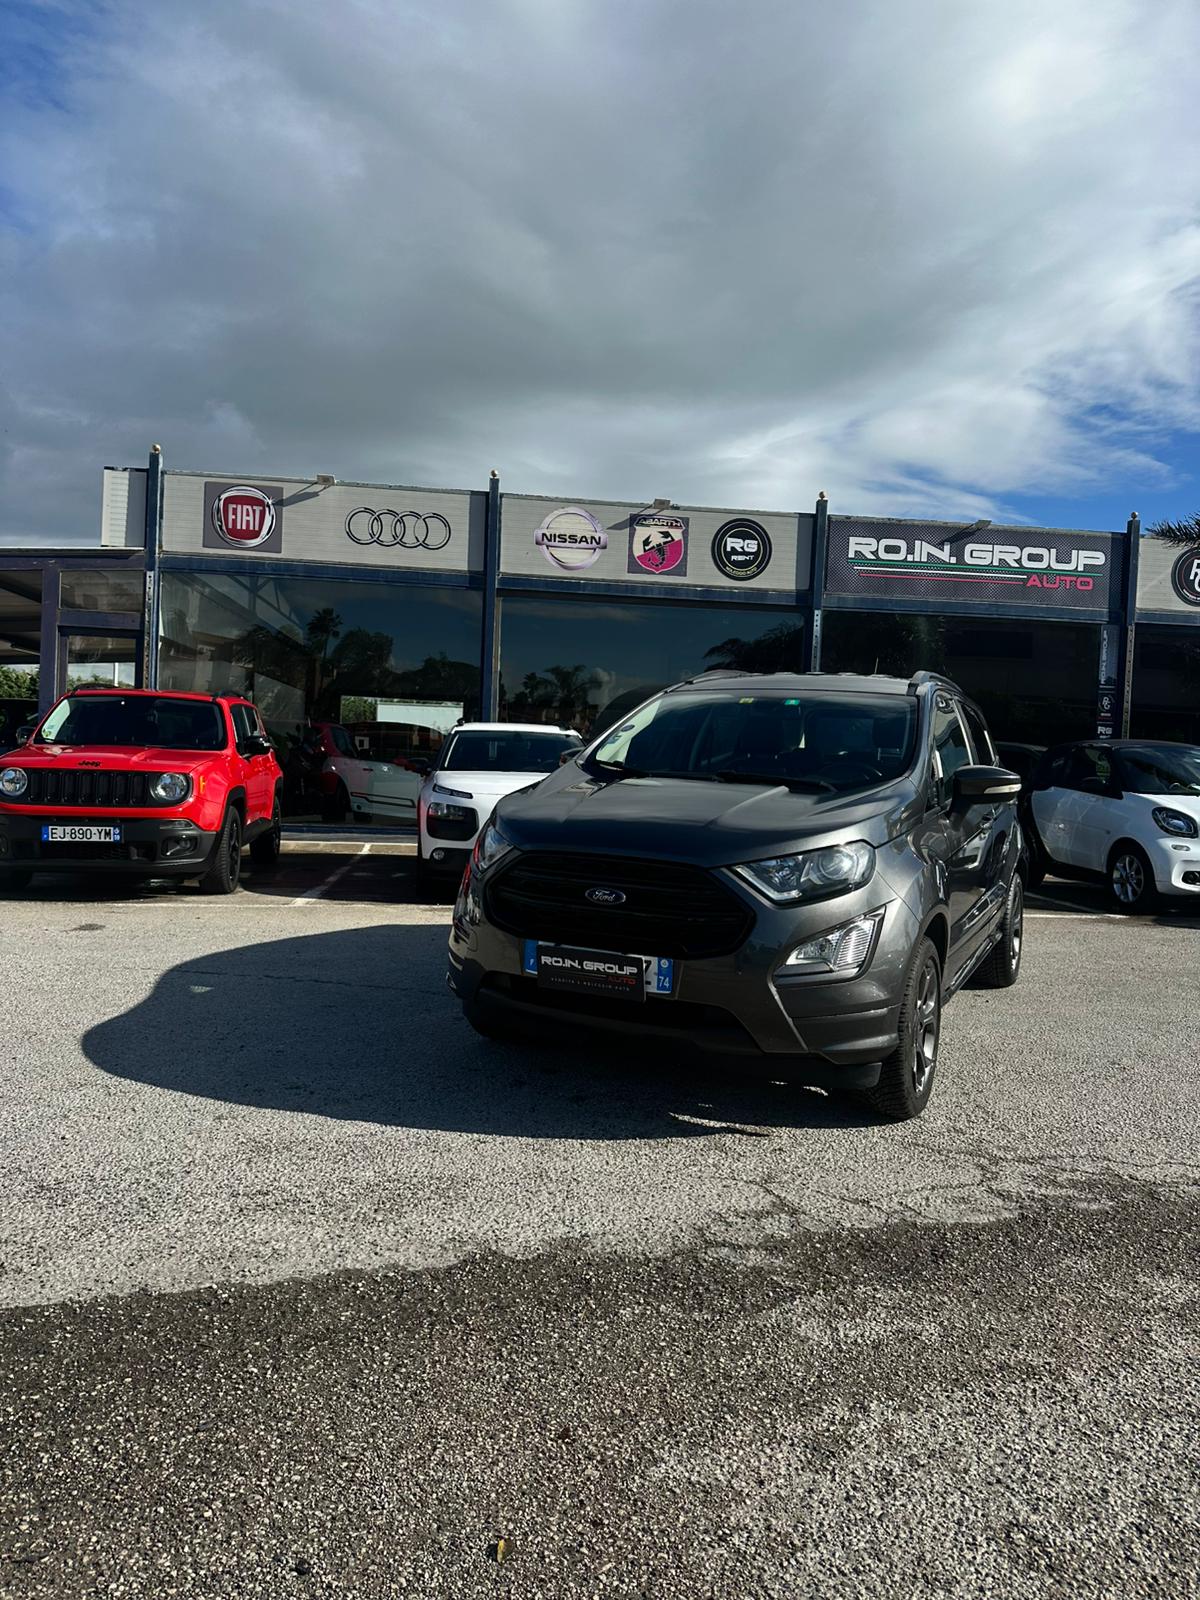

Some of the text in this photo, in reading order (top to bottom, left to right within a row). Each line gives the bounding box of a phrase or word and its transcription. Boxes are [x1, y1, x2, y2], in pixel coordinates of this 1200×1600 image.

[227, 503, 263, 531] FIAT
[639, 518, 681, 527] ABARTH
[541, 532, 601, 545] NISSAN
[726, 537, 758, 552] RG
[848, 536, 1106, 571] RO.IN. GROUP
[1026, 575, 1094, 590] AUTO
[592, 889, 616, 902] Ford
[541, 955, 581, 969] RO.IN.
[583, 961, 638, 975] GROUP
[608, 976, 636, 985] AUTO
[659, 976, 670, 989] 74
